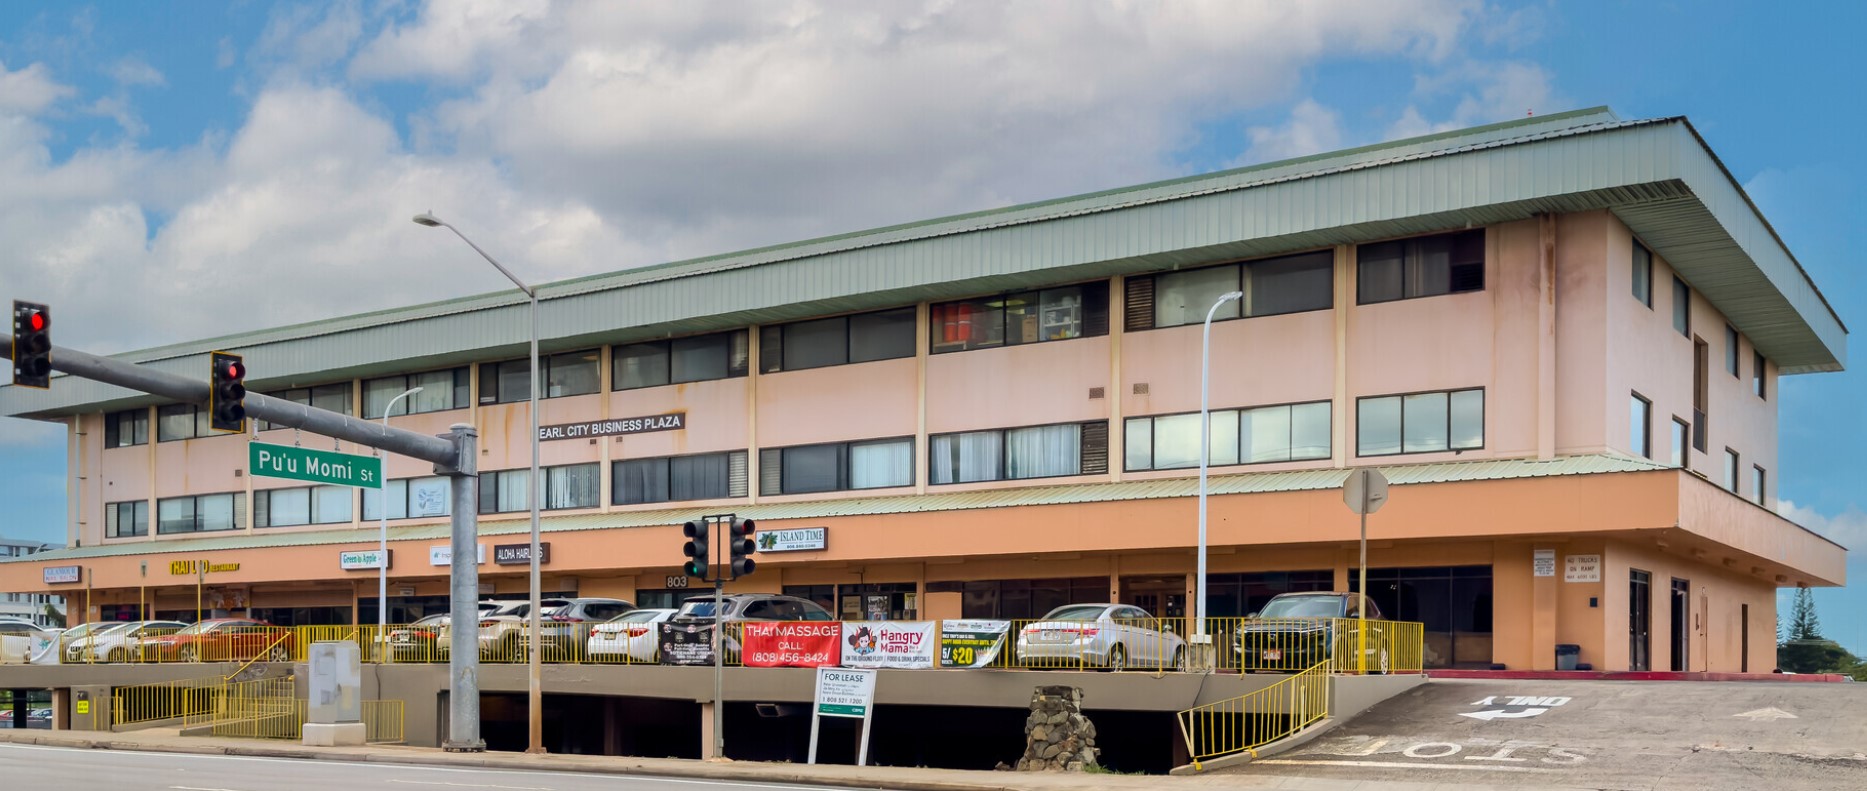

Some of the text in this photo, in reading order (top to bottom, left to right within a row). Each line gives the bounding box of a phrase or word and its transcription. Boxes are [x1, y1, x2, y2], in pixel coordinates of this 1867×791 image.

[540, 416, 680, 439] EARL CITY BUSINESS PLAZA
[259, 450, 373, 482] Pu'u Momi St
[780, 530, 823, 542] ISLAND TIME
[363, 554, 376, 564] Apple
[498, 548, 516, 560] ALOHA
[170, 560, 190, 575] THAI
[191, 560, 209, 574] LO
[667, 576, 687, 587] 803
[746, 626, 838, 636] THAI MASSAGE
[881, 629, 923, 646] Hangry
[881, 643, 909, 654] Mama
[752, 652, 829, 662] (808) 456-8424
[953, 647, 973, 664] $20
[1470, 696, 1572, 706] ONLY
